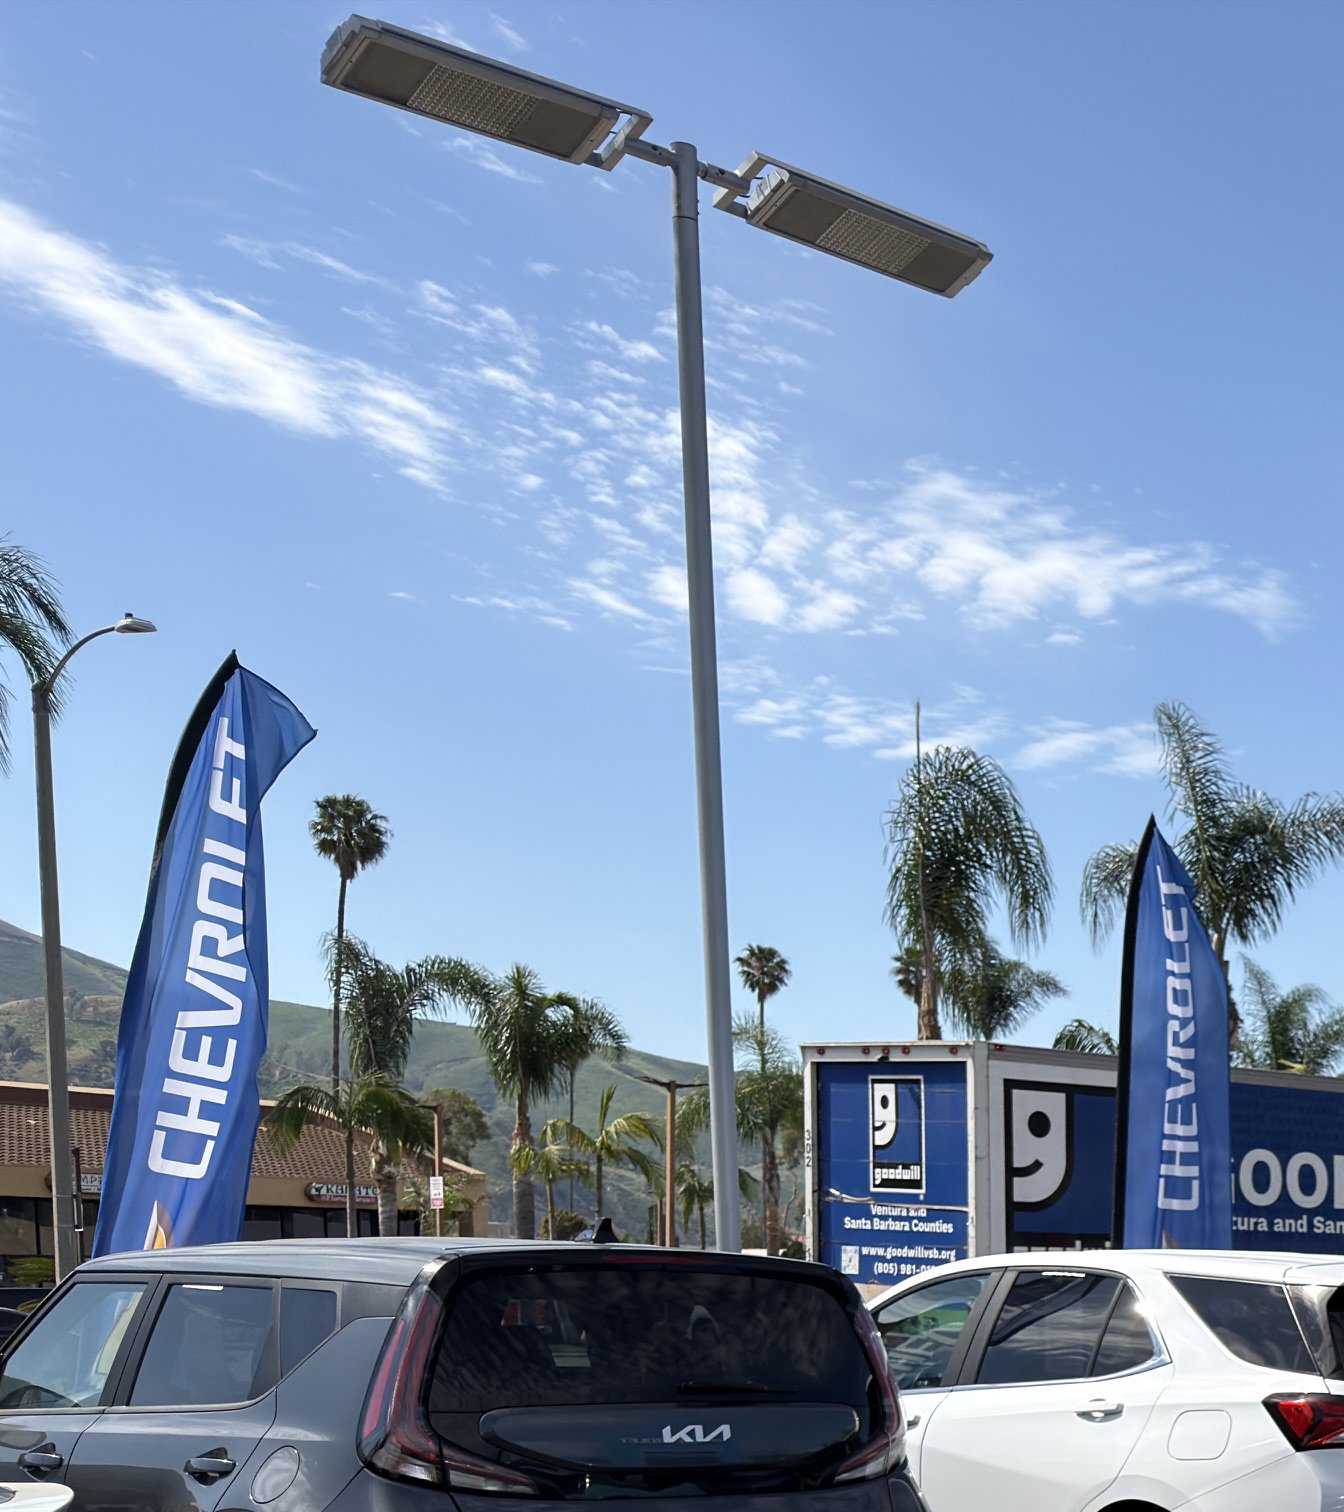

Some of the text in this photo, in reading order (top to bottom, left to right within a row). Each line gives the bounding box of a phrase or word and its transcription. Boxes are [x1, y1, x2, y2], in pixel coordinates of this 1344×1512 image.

[1157, 865, 1200, 1211] CHEVROLET
[874, 1164, 921, 1185] goodwill
[871, 1204, 907, 1217] Ventura
[844, 1216, 954, 1234] Santa Barbara Counties
[1273, 1214, 1308, 1233] and
[861, 1245, 956, 1262] www.goodwillvsb.org
[873, 1261, 898, 1276] (805)
[662, 1424, 732, 1443] KIA
